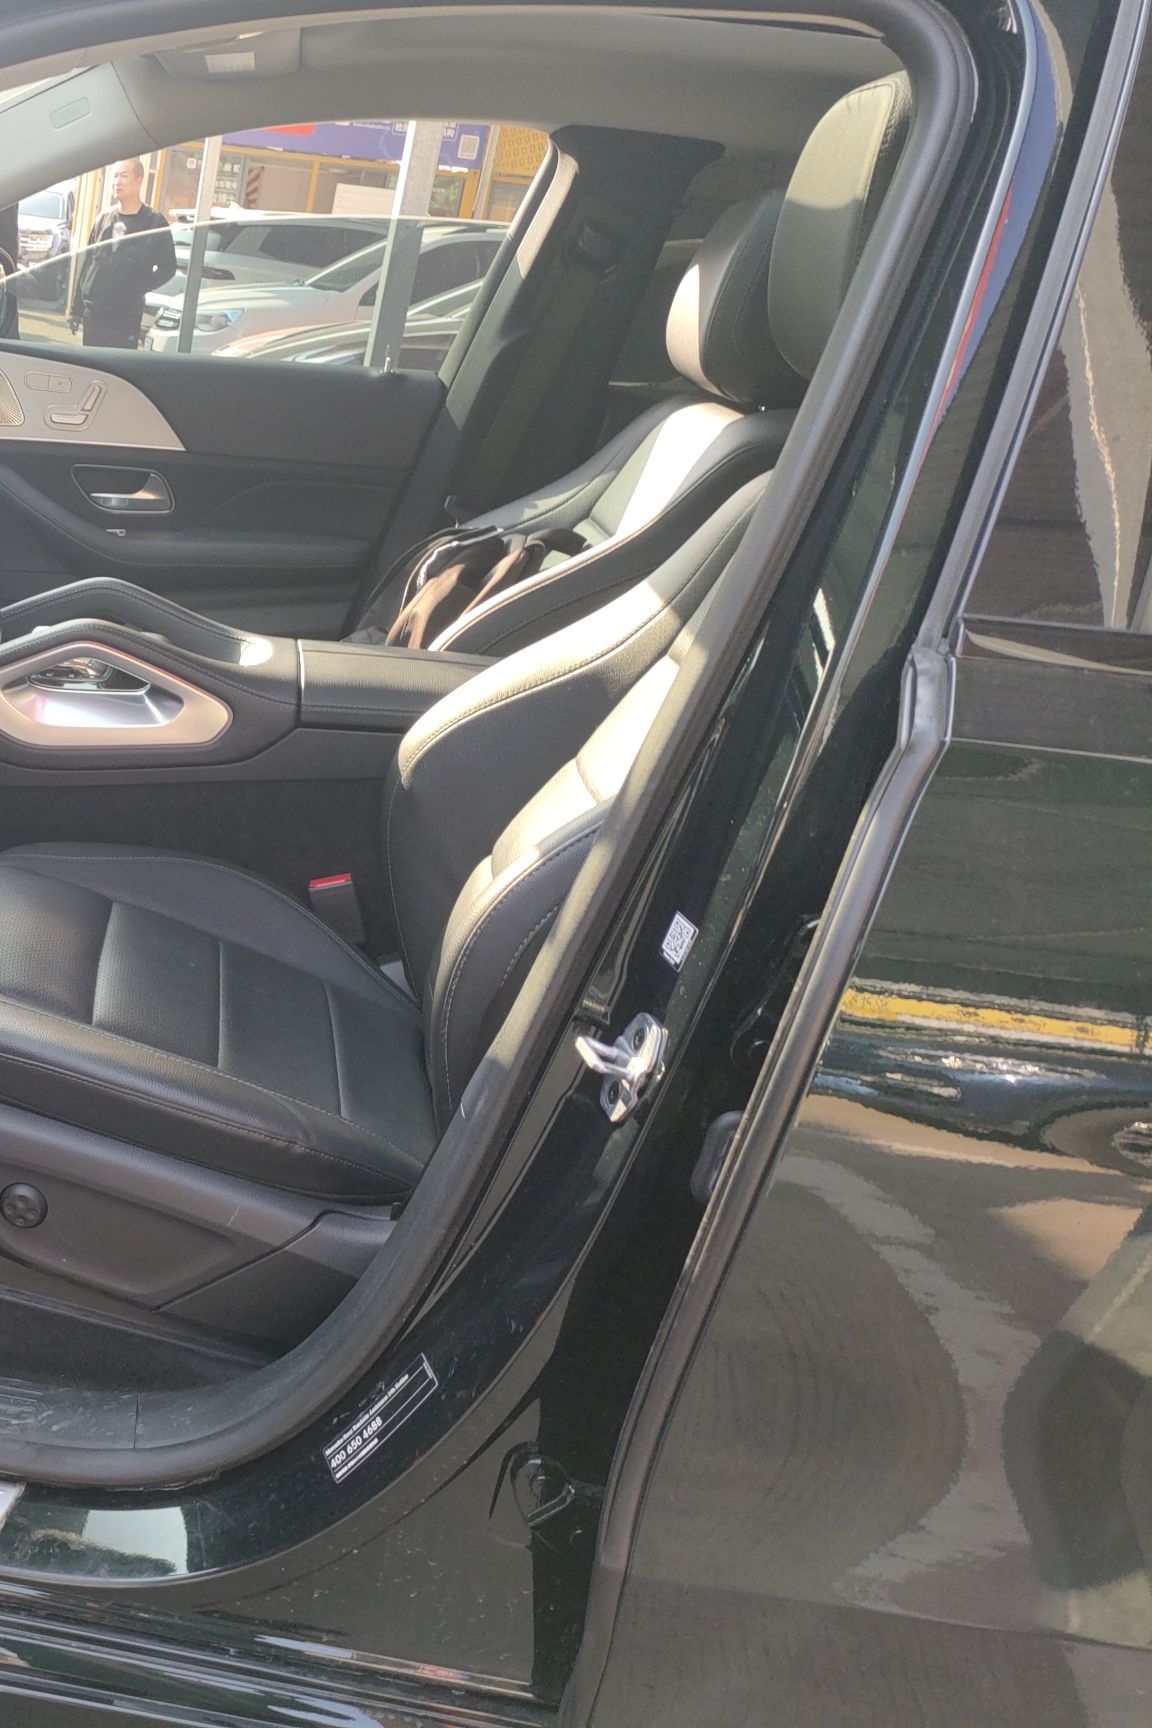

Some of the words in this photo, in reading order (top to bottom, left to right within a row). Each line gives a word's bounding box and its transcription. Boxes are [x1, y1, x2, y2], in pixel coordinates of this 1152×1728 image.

[330, 1450, 347, 1468] 400
[346, 1436, 363, 1454] 650
[362, 1416, 383, 1438] 4688
